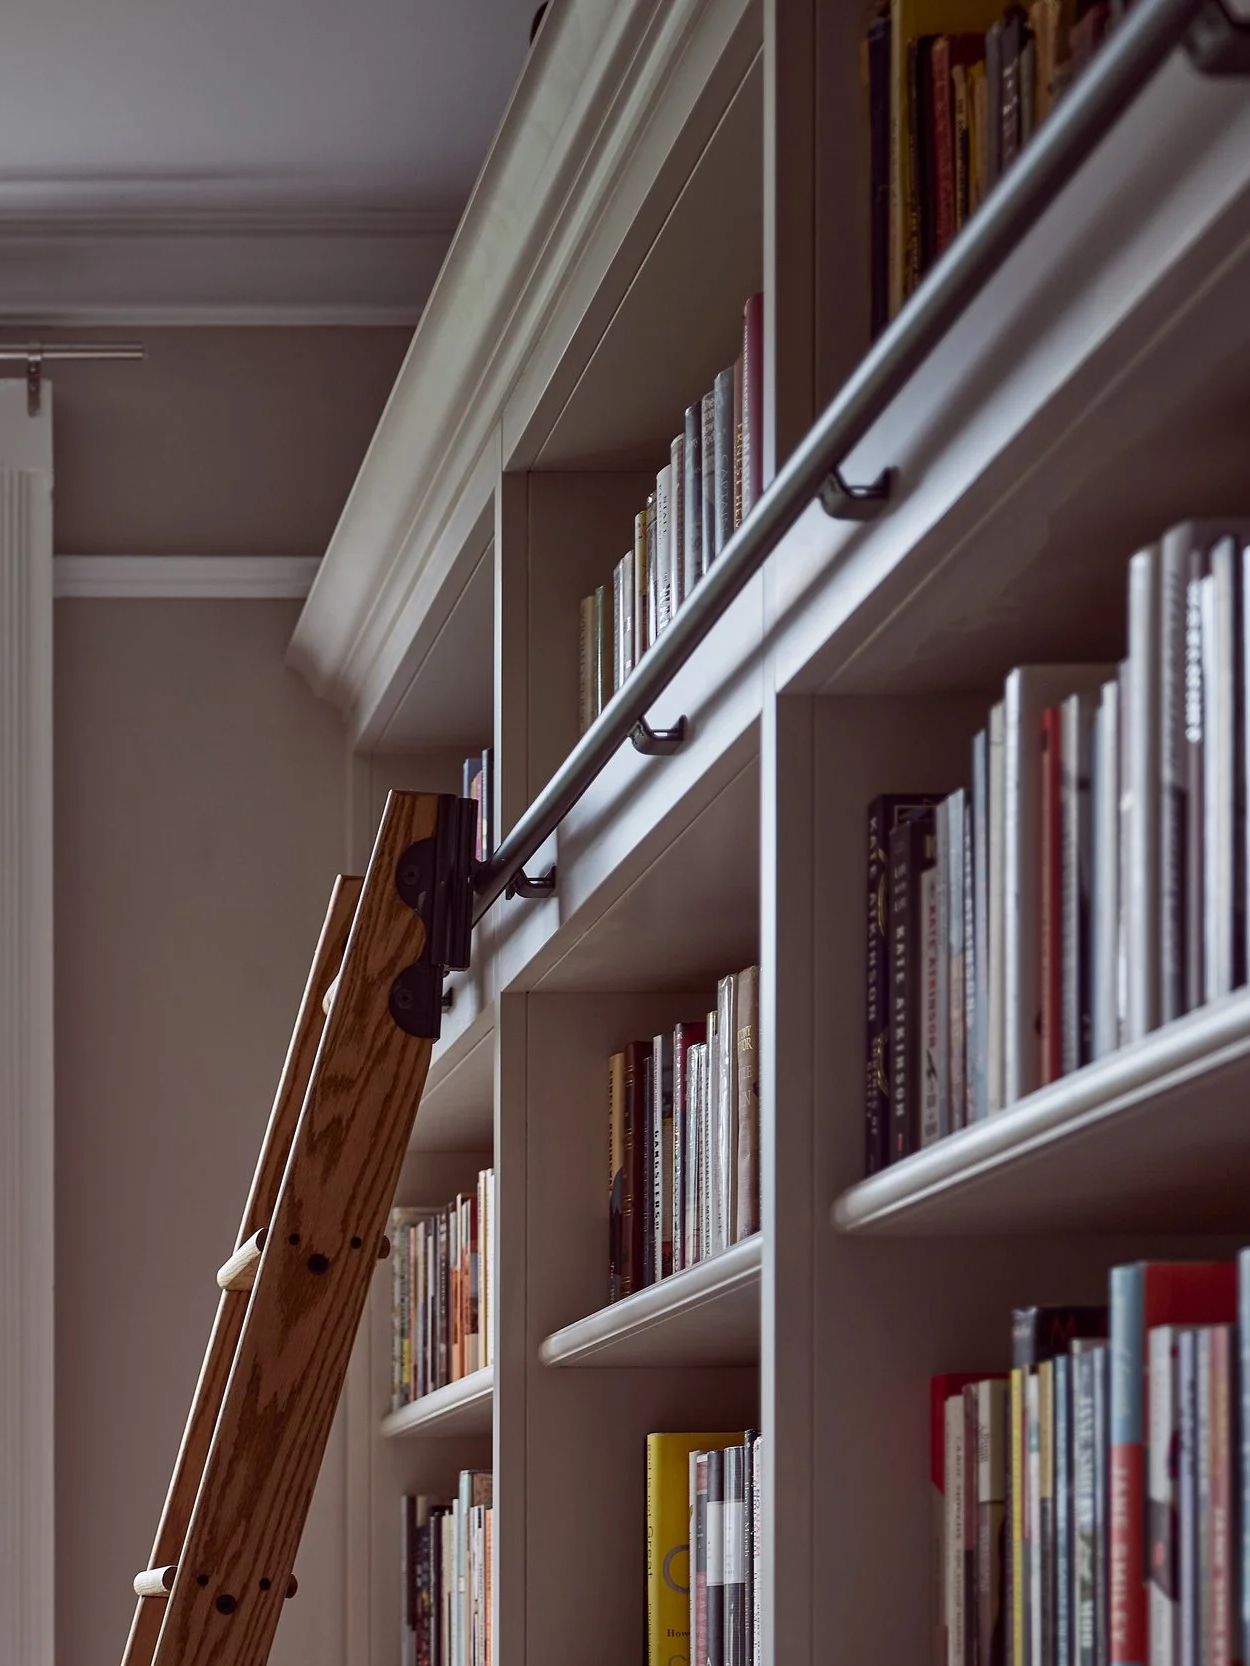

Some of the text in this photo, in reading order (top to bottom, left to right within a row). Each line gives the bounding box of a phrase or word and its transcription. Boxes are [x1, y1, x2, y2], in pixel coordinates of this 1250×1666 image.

[868, 817, 877, 1020] KATE ATKINSON
[896, 926, 905, 1118] KATE ATKINSON
[928, 957, 936, 1048] ATKINSON
[756, 1488, 760, 1508] NO
[1113, 1466, 1128, 1642] JANE SMILEY
[1079, 1600, 1093, 1648] MOO
